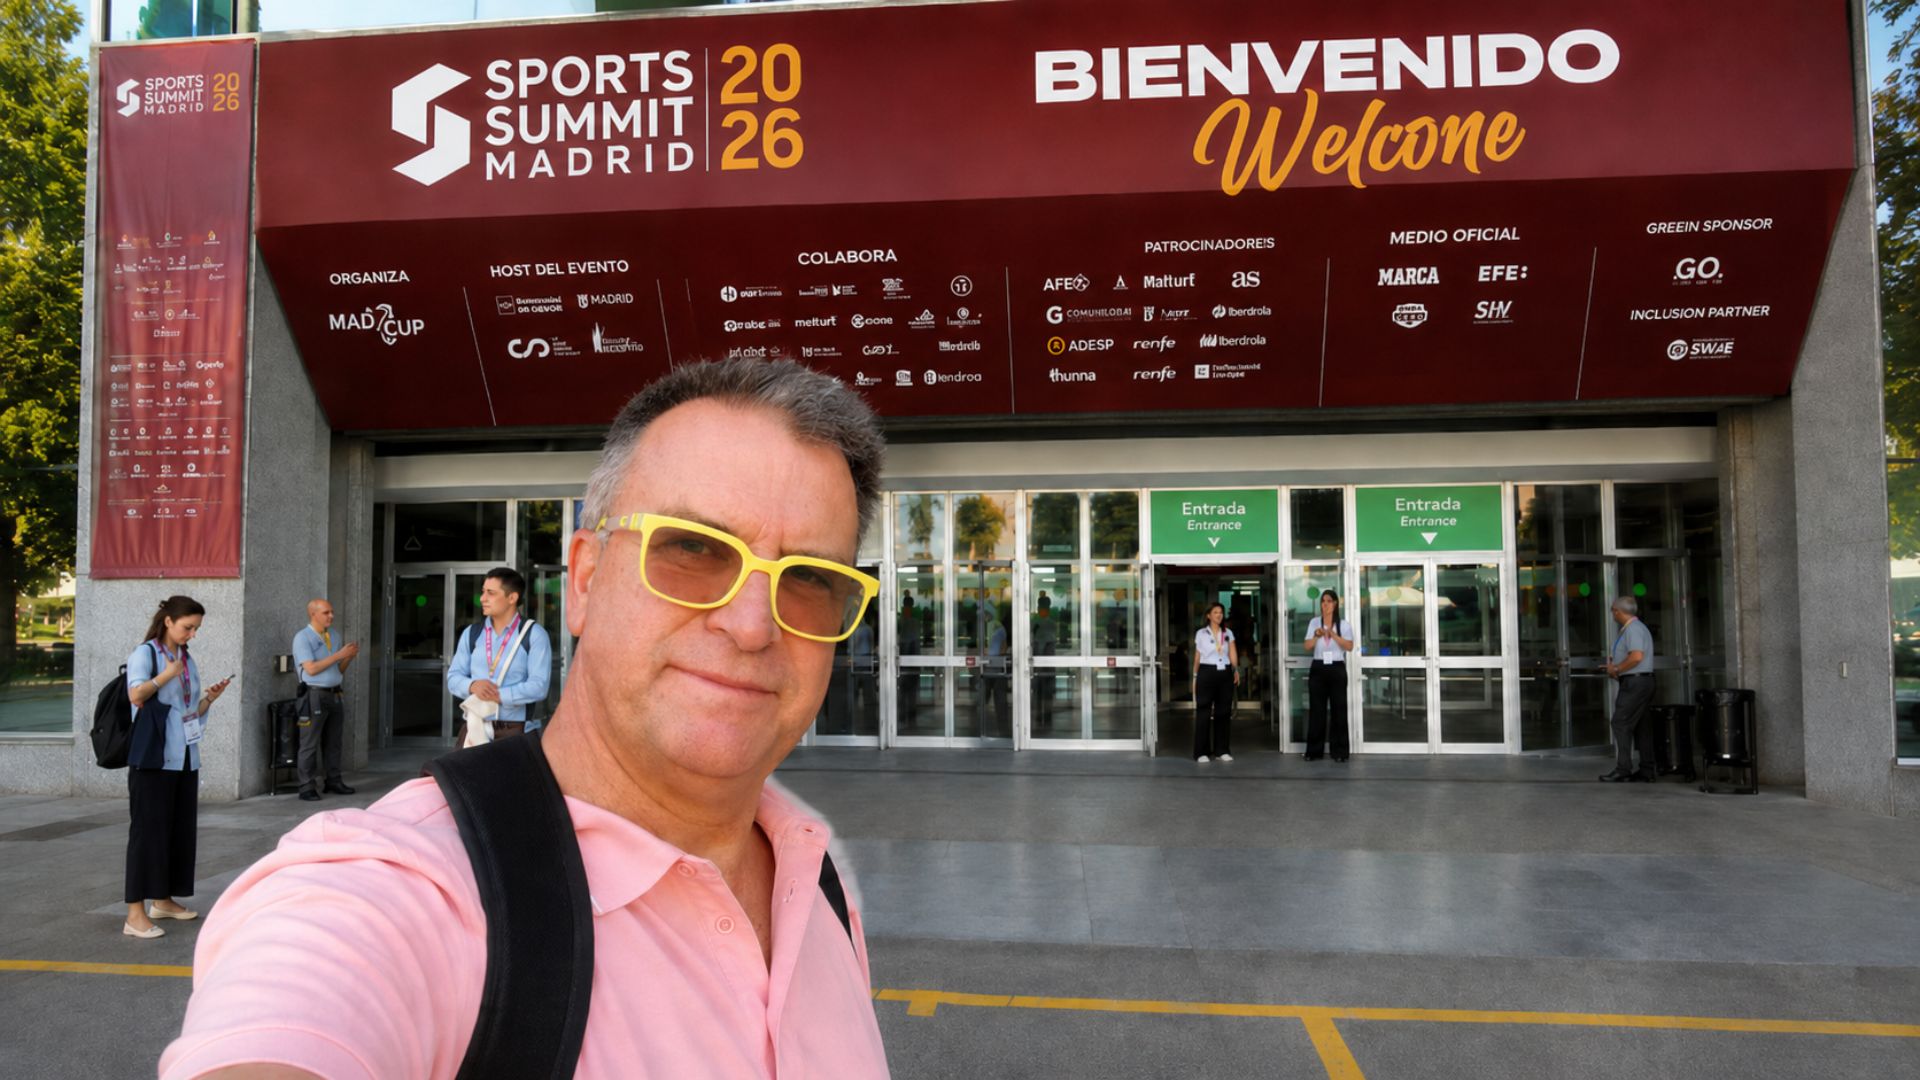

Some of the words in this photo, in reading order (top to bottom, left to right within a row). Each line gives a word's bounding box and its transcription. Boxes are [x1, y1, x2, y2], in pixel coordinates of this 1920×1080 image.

[485, 50, 694, 100] SPORTS
[719, 43, 802, 105] 20
[1035, 29, 1621, 103] BIENVENIDO
[144, 74, 204, 90] SPORTS
[213, 72, 240, 92] 20
[144, 88, 204, 104] SUMMIT
[213, 92, 240, 112] 26
[144, 102, 204, 115] MADRID
[485, 96, 694, 146] SUMMIT
[720, 107, 804, 170] 26
[485, 142, 694, 181] MADRID
[1702, 218, 1773, 232] SPONSOR
[1389, 230, 1448, 245] MEDIO
[1453, 227, 1520, 242] OFICIAL
[797, 249, 898, 265] COLABORA
[329, 269, 410, 285] ORGANIZA
[490, 264, 531, 278] HOST
[536, 262, 565, 276] DEL
[568, 260, 629, 275] EVENTO
[1378, 266, 1440, 286] MARCA
[1043, 277, 1074, 291] AFE
[1231, 270, 1261, 288] as
[591, 293, 634, 306] MADRID
[1228, 306, 1272, 317] Iberdrola
[1630, 306, 1705, 322] INCLUSION
[1708, 304, 1771, 318] PARTNER
[328, 312, 375, 331] MAD
[383, 318, 425, 337] CUP
[1068, 339, 1115, 352] ADESP
[1133, 335, 1176, 352] renfe
[1219, 334, 1267, 346] Iberdrola
[1133, 365, 1176, 382] renfe
[1182, 502, 1246, 516] Entrada
[1395, 498, 1462, 512] Entrada
[1187, 520, 1242, 530] Entrance
[1400, 516, 1457, 527] Entrance
